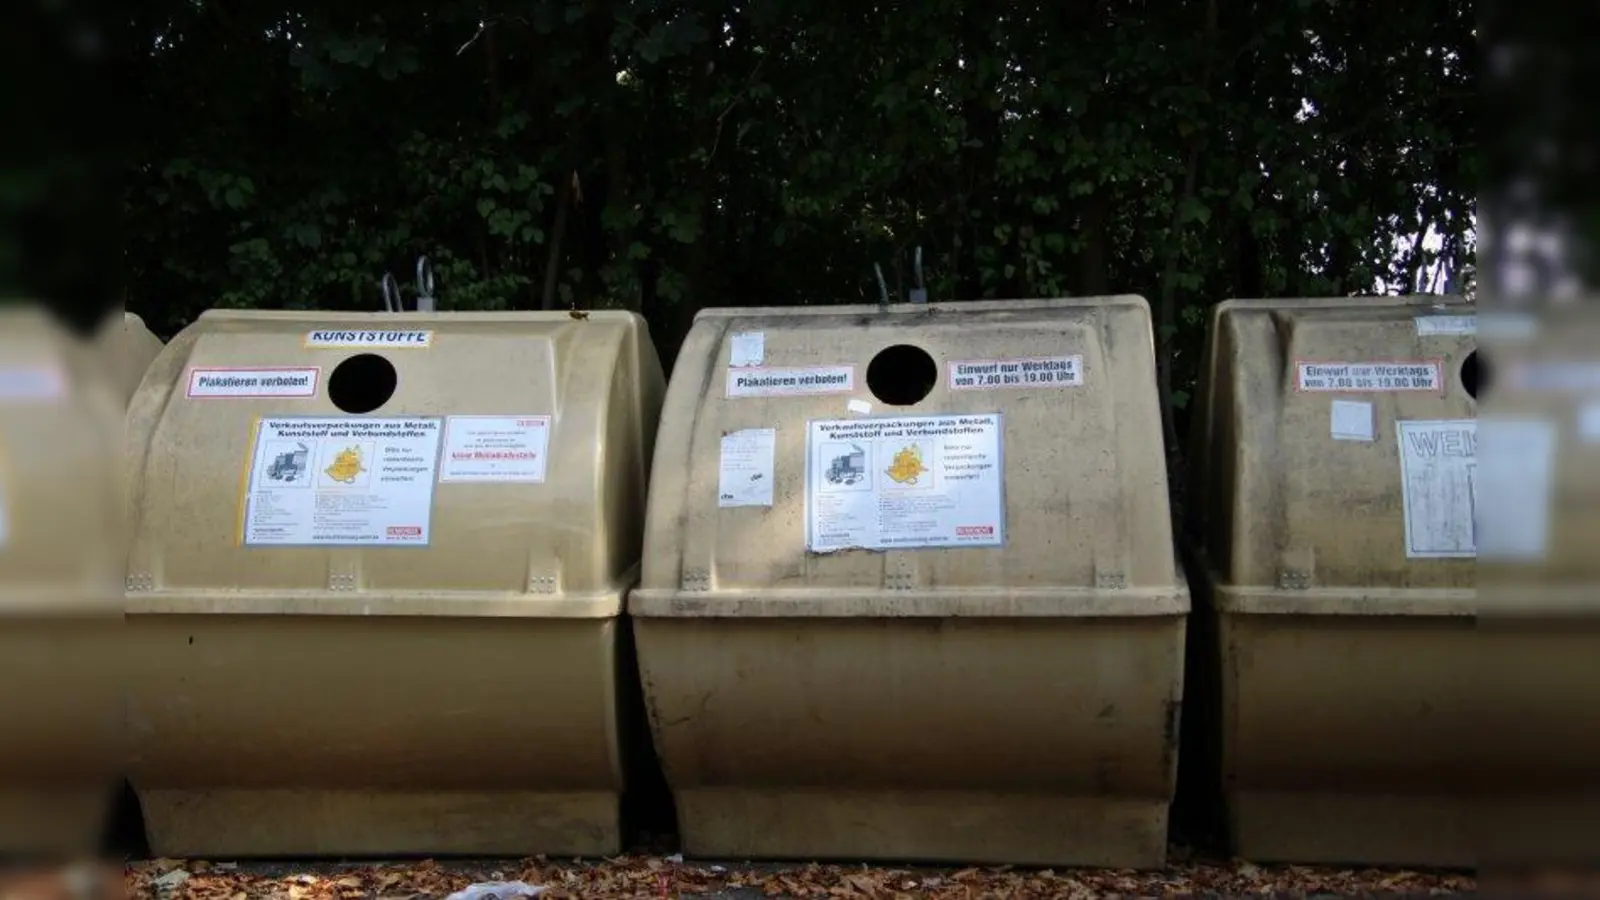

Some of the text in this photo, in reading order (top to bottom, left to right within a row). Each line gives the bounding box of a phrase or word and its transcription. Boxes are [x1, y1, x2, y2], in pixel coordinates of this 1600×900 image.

[957, 360, 1073, 374] Einwurf nur Werktags
[1306, 366, 1348, 376] Einwurf
[1374, 366, 1429, 377] Werktags
[199, 376, 308, 387] Plakatieren verboten!
[737, 374, 847, 387] Plakatieren verboten!
[955, 371, 1075, 385] von 7.00 bis 19.00 Uhr
[1305, 377, 1433, 387] von 7.00 bis 19.00 Uhr
[829, 430, 881, 440] Kunststoff
